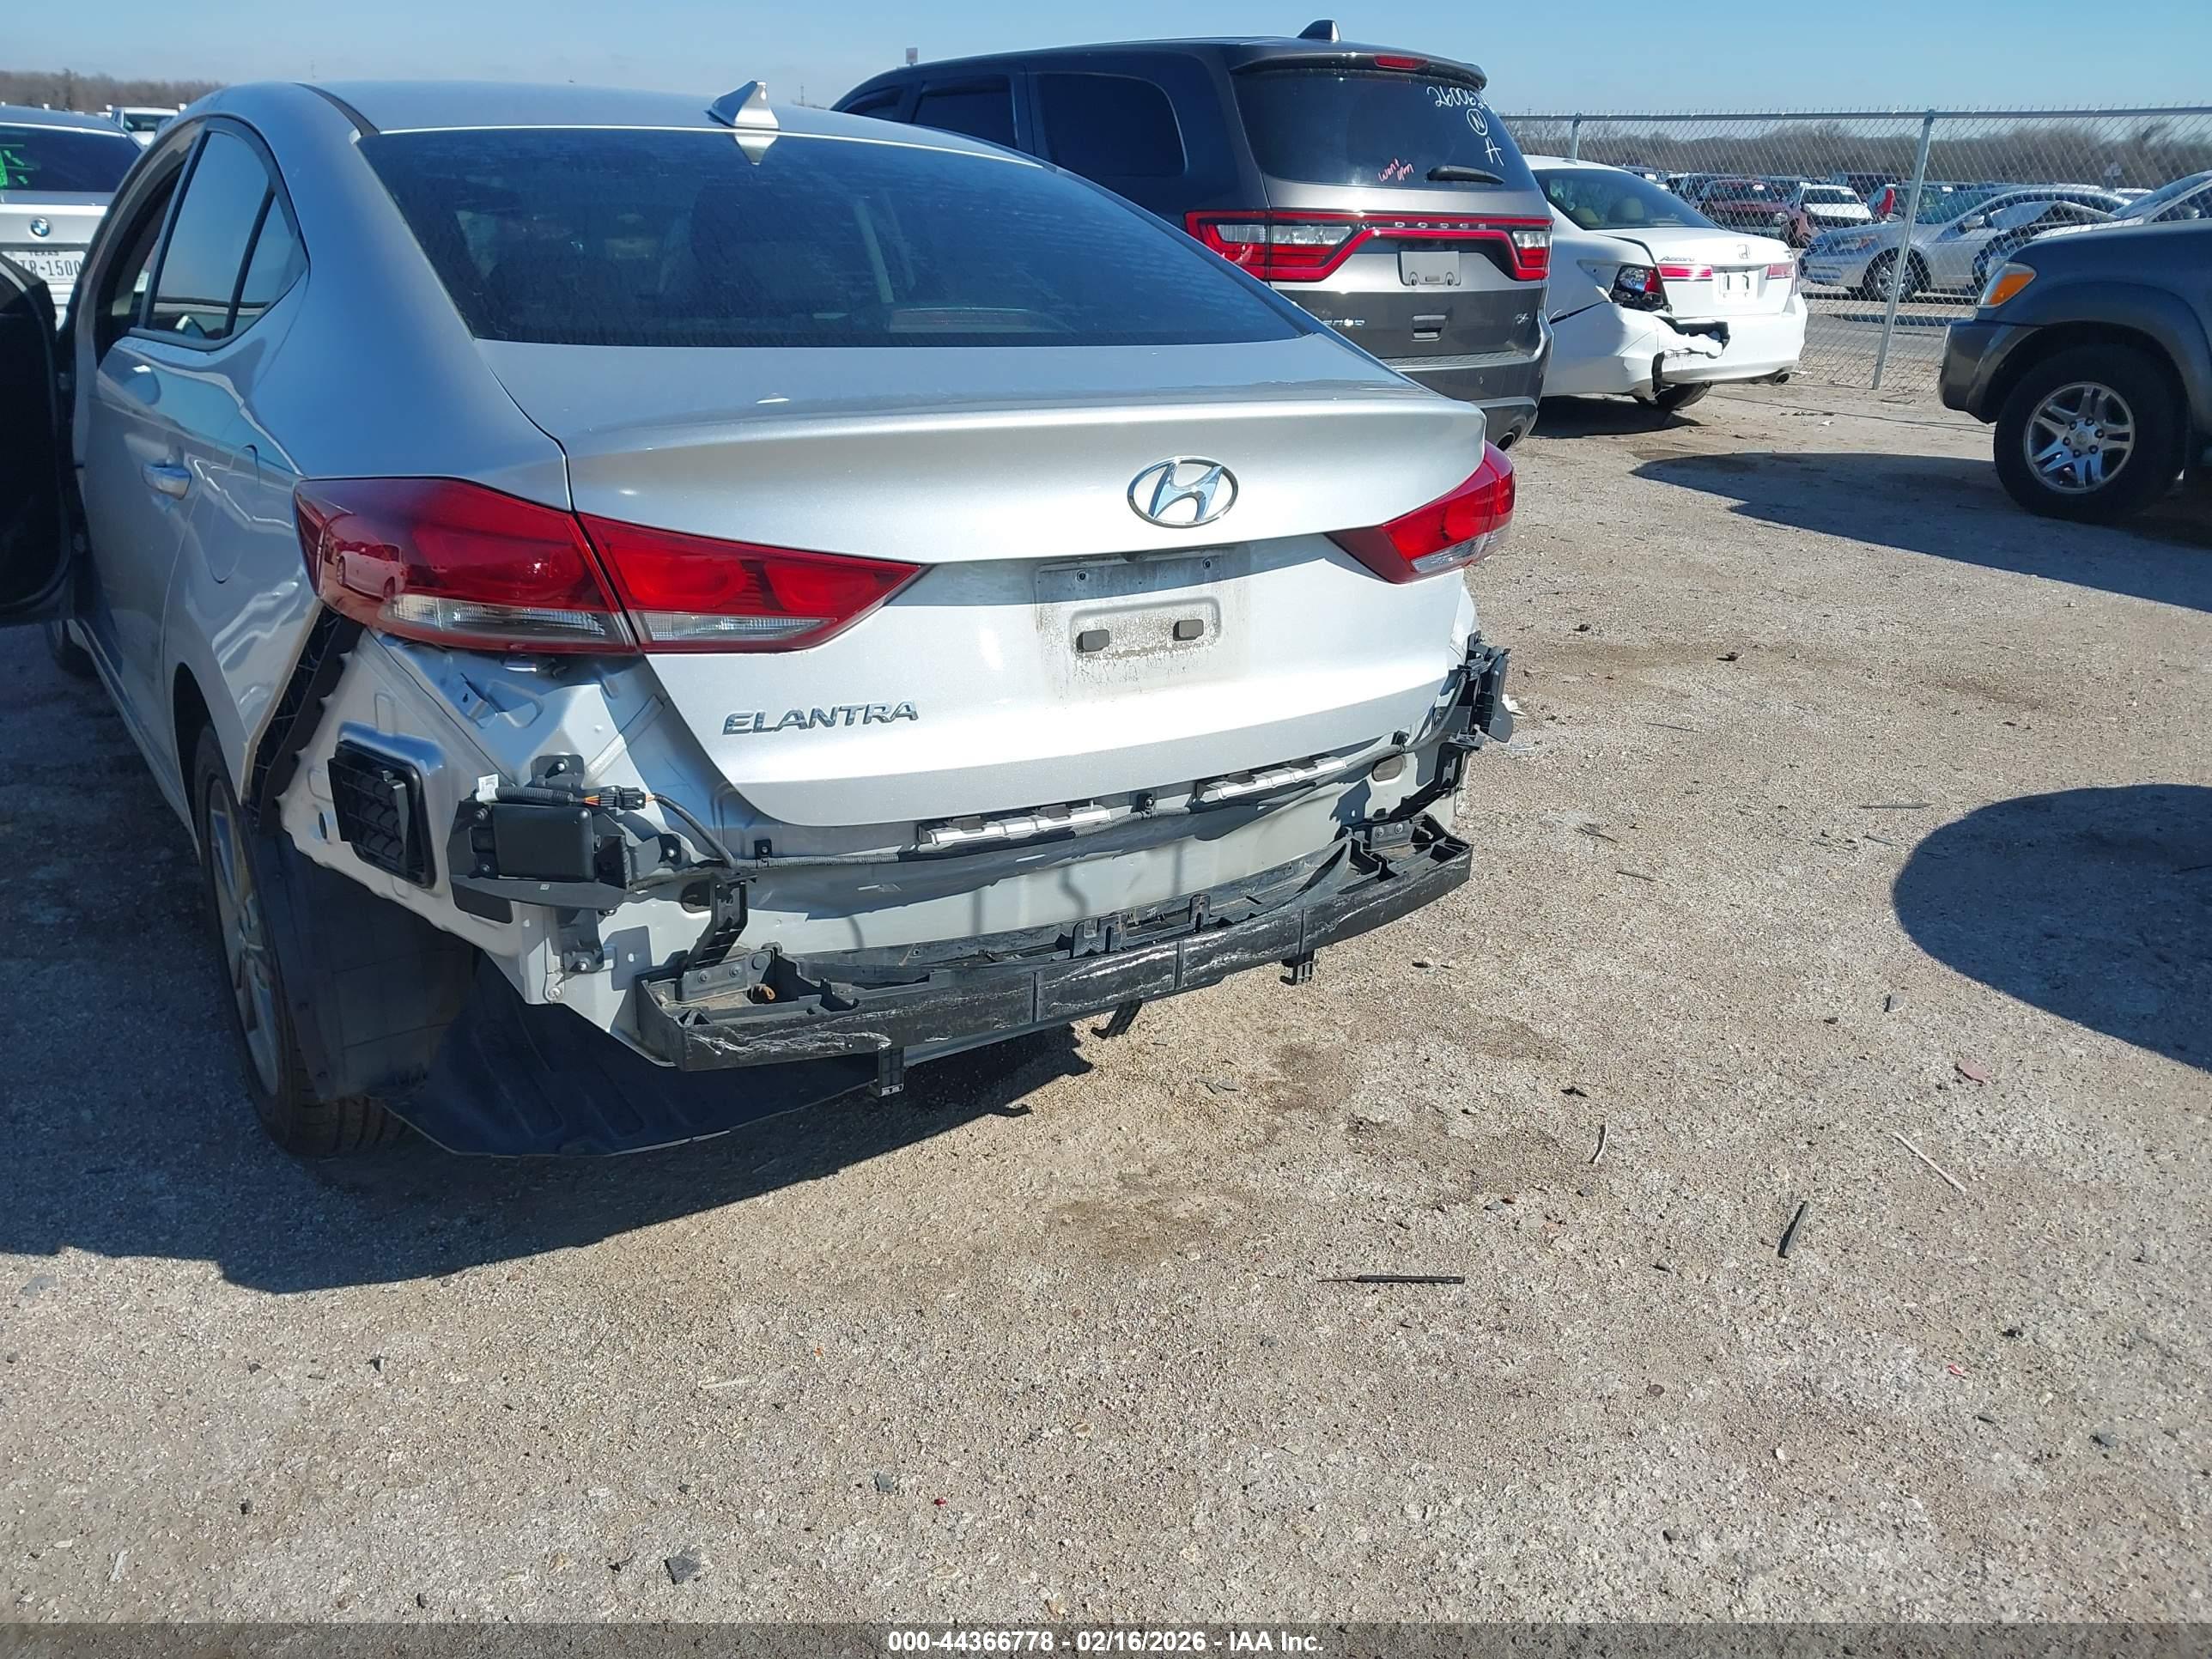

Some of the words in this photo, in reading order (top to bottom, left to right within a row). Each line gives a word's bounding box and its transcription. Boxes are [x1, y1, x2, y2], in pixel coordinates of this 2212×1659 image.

[1485, 137, 1504, 167] A
[1395, 221, 1487, 230] DODGE
[721, 700, 920, 735] ELANTRA
